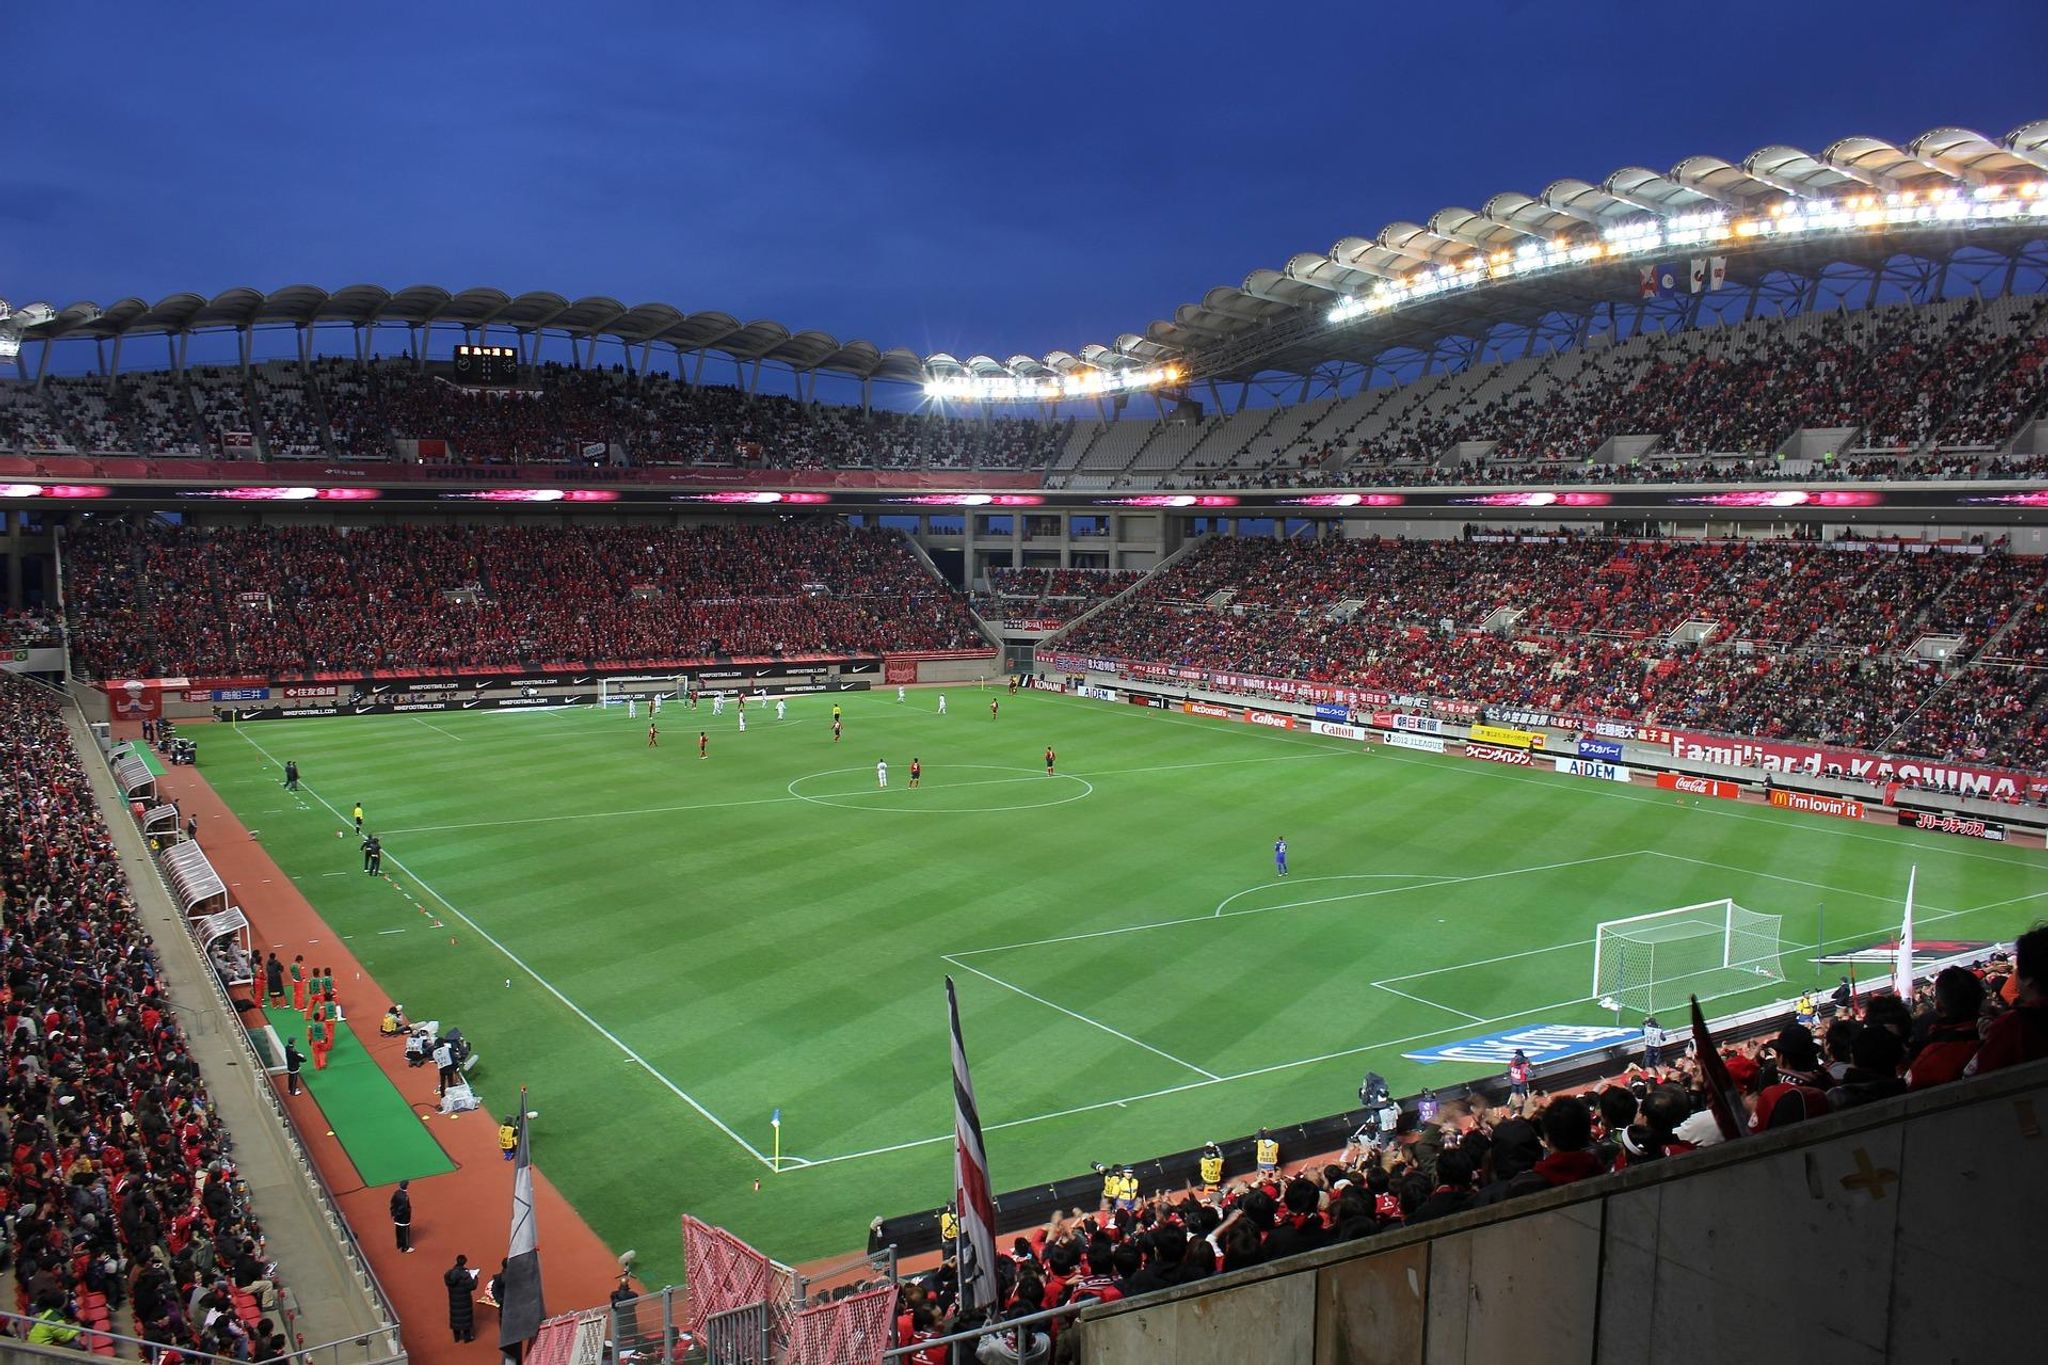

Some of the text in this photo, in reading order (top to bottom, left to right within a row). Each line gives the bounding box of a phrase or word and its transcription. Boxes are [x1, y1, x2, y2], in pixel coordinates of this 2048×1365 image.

[1034, 680, 1061, 692] KONAMI
[221, 690, 261, 700] 商船三井
[283, 708, 337, 716] NIKEFOOTBALL.COM
[394, 703, 445, 711] NIKEFOOTBALL.COM
[1192, 705, 1227, 717] McDonald's
[1250, 712, 1287, 727] Calbee
[1397, 716, 1437, 731] 朝日新聞
[1321, 723, 1354, 738] Canon
[1392, 735, 1408, 744] 2012
[1789, 794, 1807, 808] i'm
[1810, 798, 1845, 815] lovin'
[1847, 803, 1856, 817] it
